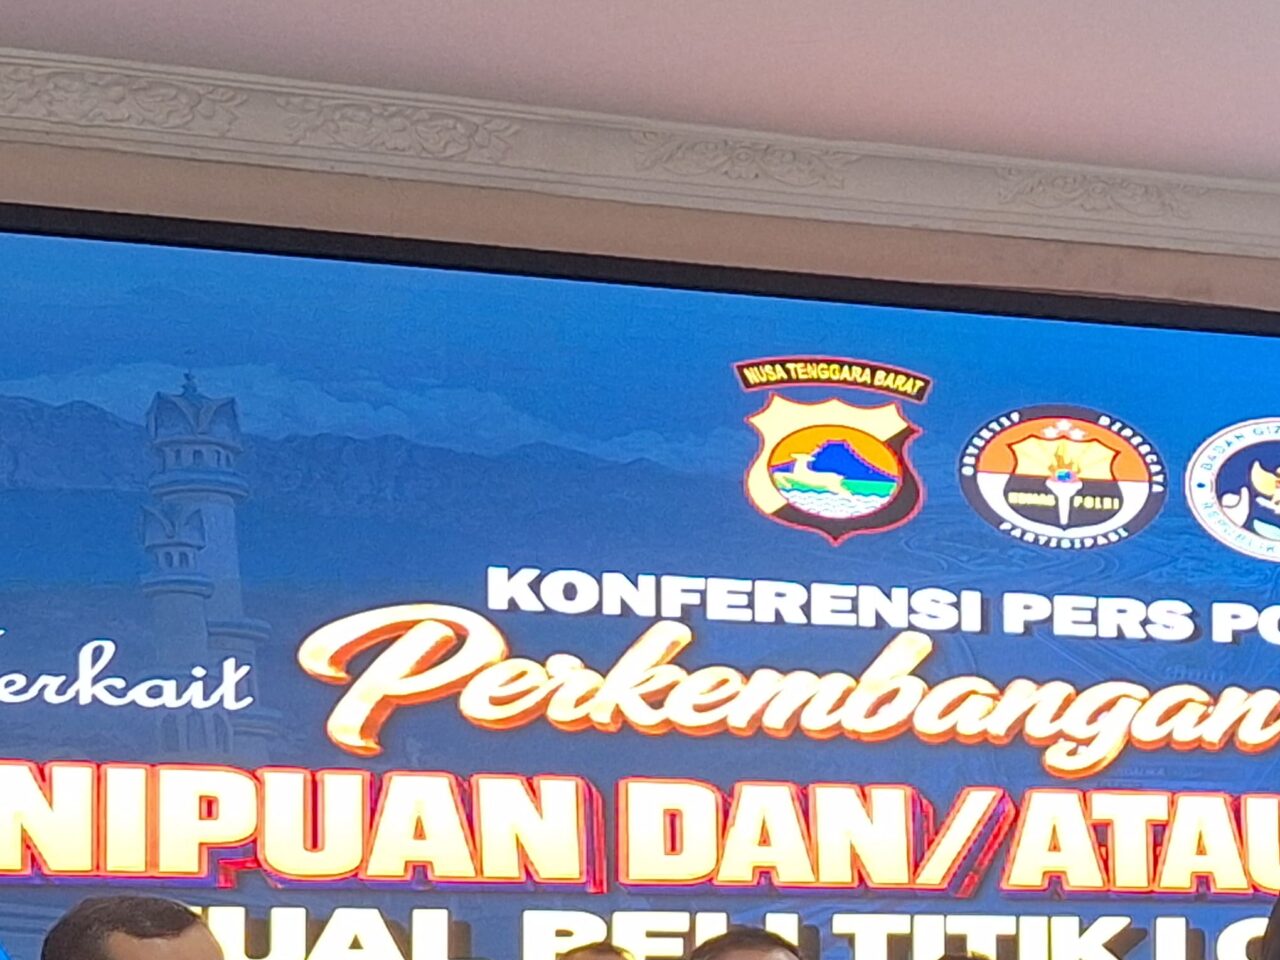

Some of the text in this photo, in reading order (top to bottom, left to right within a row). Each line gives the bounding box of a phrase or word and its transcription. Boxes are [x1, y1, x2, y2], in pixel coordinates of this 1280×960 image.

[743, 362, 925, 395] NUSA TENGGARA BARAT
[487, 565, 980, 632] KONFERENSI
[1002, 591, 1195, 641] PERS
[0, 629, 254, 711] erkait
[0, 758, 600, 890] NIPUAN
